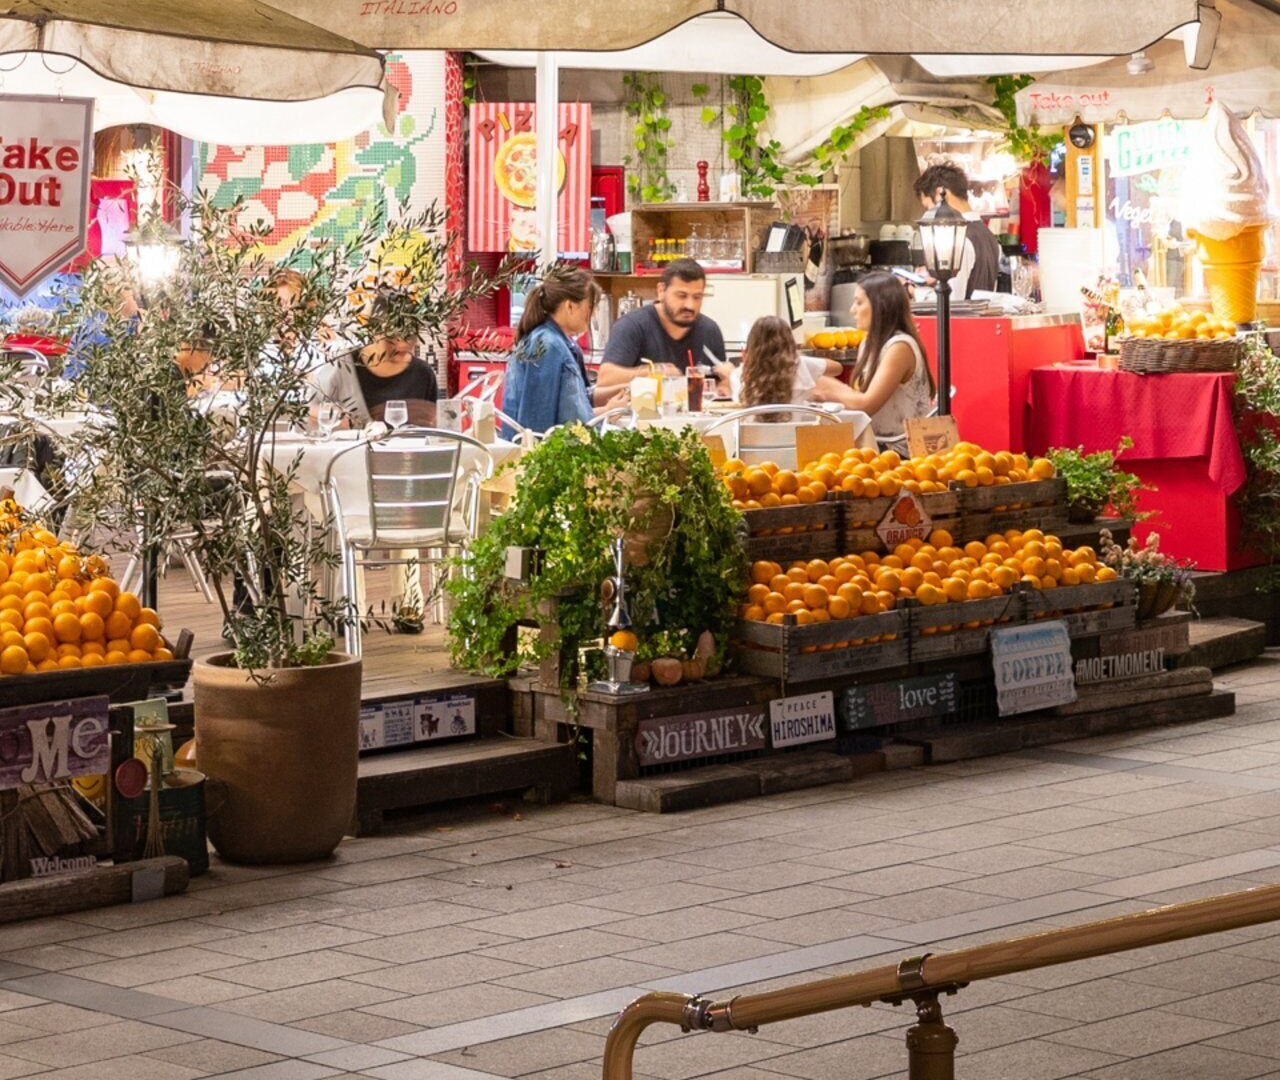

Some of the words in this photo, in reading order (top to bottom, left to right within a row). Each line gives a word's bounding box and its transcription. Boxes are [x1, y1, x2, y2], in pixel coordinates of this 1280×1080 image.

[360, 0, 458, 16] ITALIANO
[1030, 92, 1074, 110] Take
[1079, 90, 1111, 108] out
[477, 110, 578, 147] PIZA
[35, 217, 75, 233] Here
[886, 528, 925, 545] ORANGE
[1001, 651, 1065, 685] COFFEE
[1076, 648, 1165, 681] #MOETMOMENT
[787, 700, 817, 713] PEACE
[898, 684, 937, 710] love
[655, 713, 750, 759] JOURNEY
[773, 714, 834, 741] HIROSHIMA
[30, 854, 98, 877] Welcome
